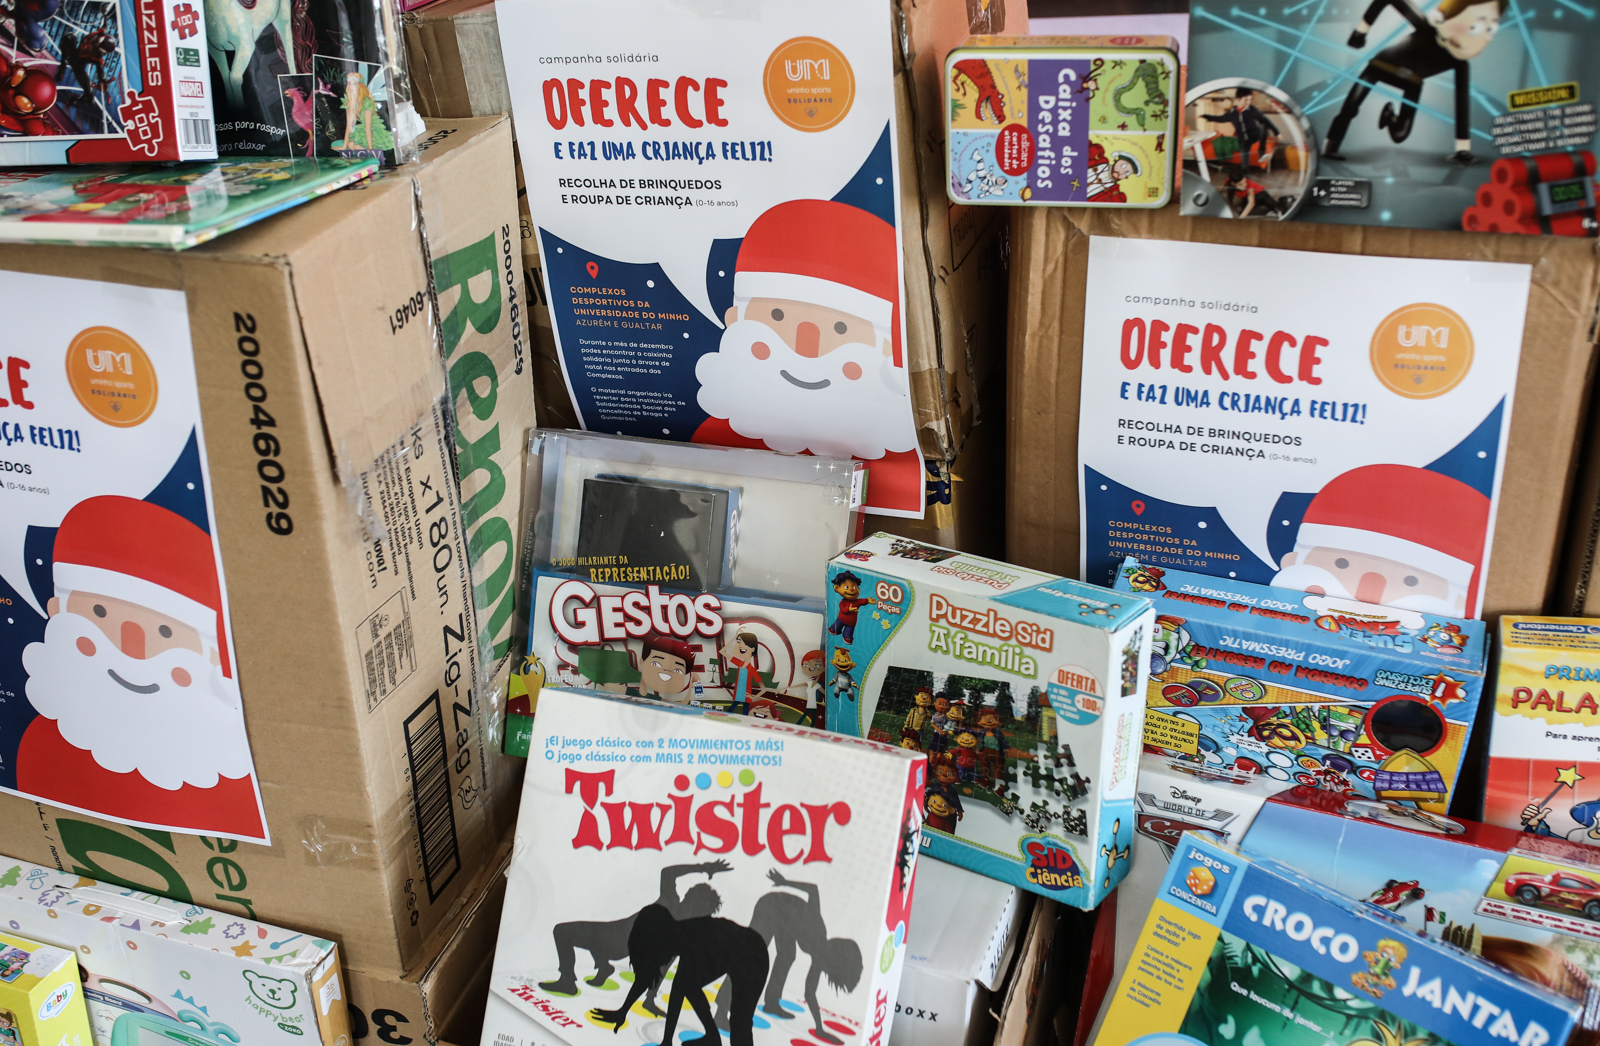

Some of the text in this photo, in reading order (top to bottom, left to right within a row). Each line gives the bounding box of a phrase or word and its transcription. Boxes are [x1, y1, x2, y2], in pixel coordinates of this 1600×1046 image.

[539, 53, 659, 65] campanha solidária
[179, 81, 204, 98] MARVEL
[810, 86, 831, 95] sports
[542, 76, 729, 130] OFERECE
[134, 102, 151, 140] 100
[235, 121, 286, 135] para raspar
[1058, 68, 1078, 175] Caixa dos
[234, 140, 266, 151] relaxar
[1037, 95, 1056, 188] Desafios
[554, 141, 773, 165] E FAZ UMA CRIANÇA FELIZ!
[559, 178, 722, 191] RECOLHA DE BRINQUEDOS
[562, 194, 739, 209] E ROUPA DE CRIANÇA anos)
[501, 223, 523, 376] 200046029
[570, 286, 626, 295] COMPLEXOS
[572, 297, 635, 307] DESPORTIVOS
[1125, 294, 1259, 314] campanha solidária
[574, 308, 639, 318] UNIVERSIDADE
[658, 313, 689, 321] MINHO
[576, 318, 662, 330] AZURÉM GUALTAR
[640, 341, 673, 350] dezembro
[1120, 317, 1330, 386] OFERECE
[1121, 382, 1367, 425] E FAZ UMA CRIANÇA FELIZ!
[233, 311, 294, 536] 200046029
[1118, 418, 1302, 447] RECOLHA DE BRINQUEDOS
[29, 425, 81, 453] FELIZ!
[1117, 435, 1266, 461] E ROUPA DE CRIANÇA
[404, 466, 418, 518] European
[414, 518, 424, 550] Union
[1109, 520, 1172, 533] COMPLEXOS
[1109, 530, 1197, 546] DESPORTIVOS DA
[559, 556, 628, 566] JOGO HILARIANTE DA
[1109, 540, 1240, 561] UNIVERSIDADE DO MINHO
[1161, 556, 1207, 567] GUALTAR
[590, 564, 690, 583] REPRESENTAÇÃO!
[957, 569, 1010, 591] Puzzle
[876, 581, 903, 604] 60
[1180, 583, 1298, 612] JOGO PRESSMATIC
[1228, 602, 1247, 614] AO
[1256, 605, 1310, 625] CORRIDA
[929, 594, 1054, 652] Puzzle Sid
[1518, 623, 1585, 632] Clementoni
[928, 624, 1037, 679] A família
[1219, 635, 1350, 669] JOGO PRESSMATIC
[1189, 644, 1369, 692] CORRIDA AO RESGATE!
[1375, 669, 1434, 686] EXCLUSIVO
[1058, 669, 1095, 694] OFERTA
[1374, 678, 1434, 695] SUPERZING
[1156, 716, 1180, 725] SALVAR
[1169, 727, 1197, 738] LIBERTAR
[1169, 732, 1194, 745] CONTRA
[1546, 731, 1567, 740] Para
[562, 737, 592, 749] juego
[595, 736, 632, 748] clásico
[636, 740, 654, 748] con
[658, 738, 665, 748] 2
[668, 738, 751, 751] MOVIMIENTOS
[755, 737, 784, 751] MÁS!
[545, 750, 782, 767] O jogo clássico com MAIS 2 MOVIMENTOS!
[564, 767, 852, 865] Twister
[1163, 801, 1206, 818] WORLD OF
[1027, 842, 1074, 870] SID
[1188, 848, 1230, 874] jogos
[1025, 867, 1084, 888] Ciência
[1170, 885, 1217, 915] CONCENTRA
[1159, 915, 1201, 940] Divertido jogo
[1243, 894, 1550, 1046] CROCO JANTAR
[46, 989, 67, 1012] Baby
[507, 984, 583, 1028] Twister
[1230, 981, 1281, 1013] Que loucura
